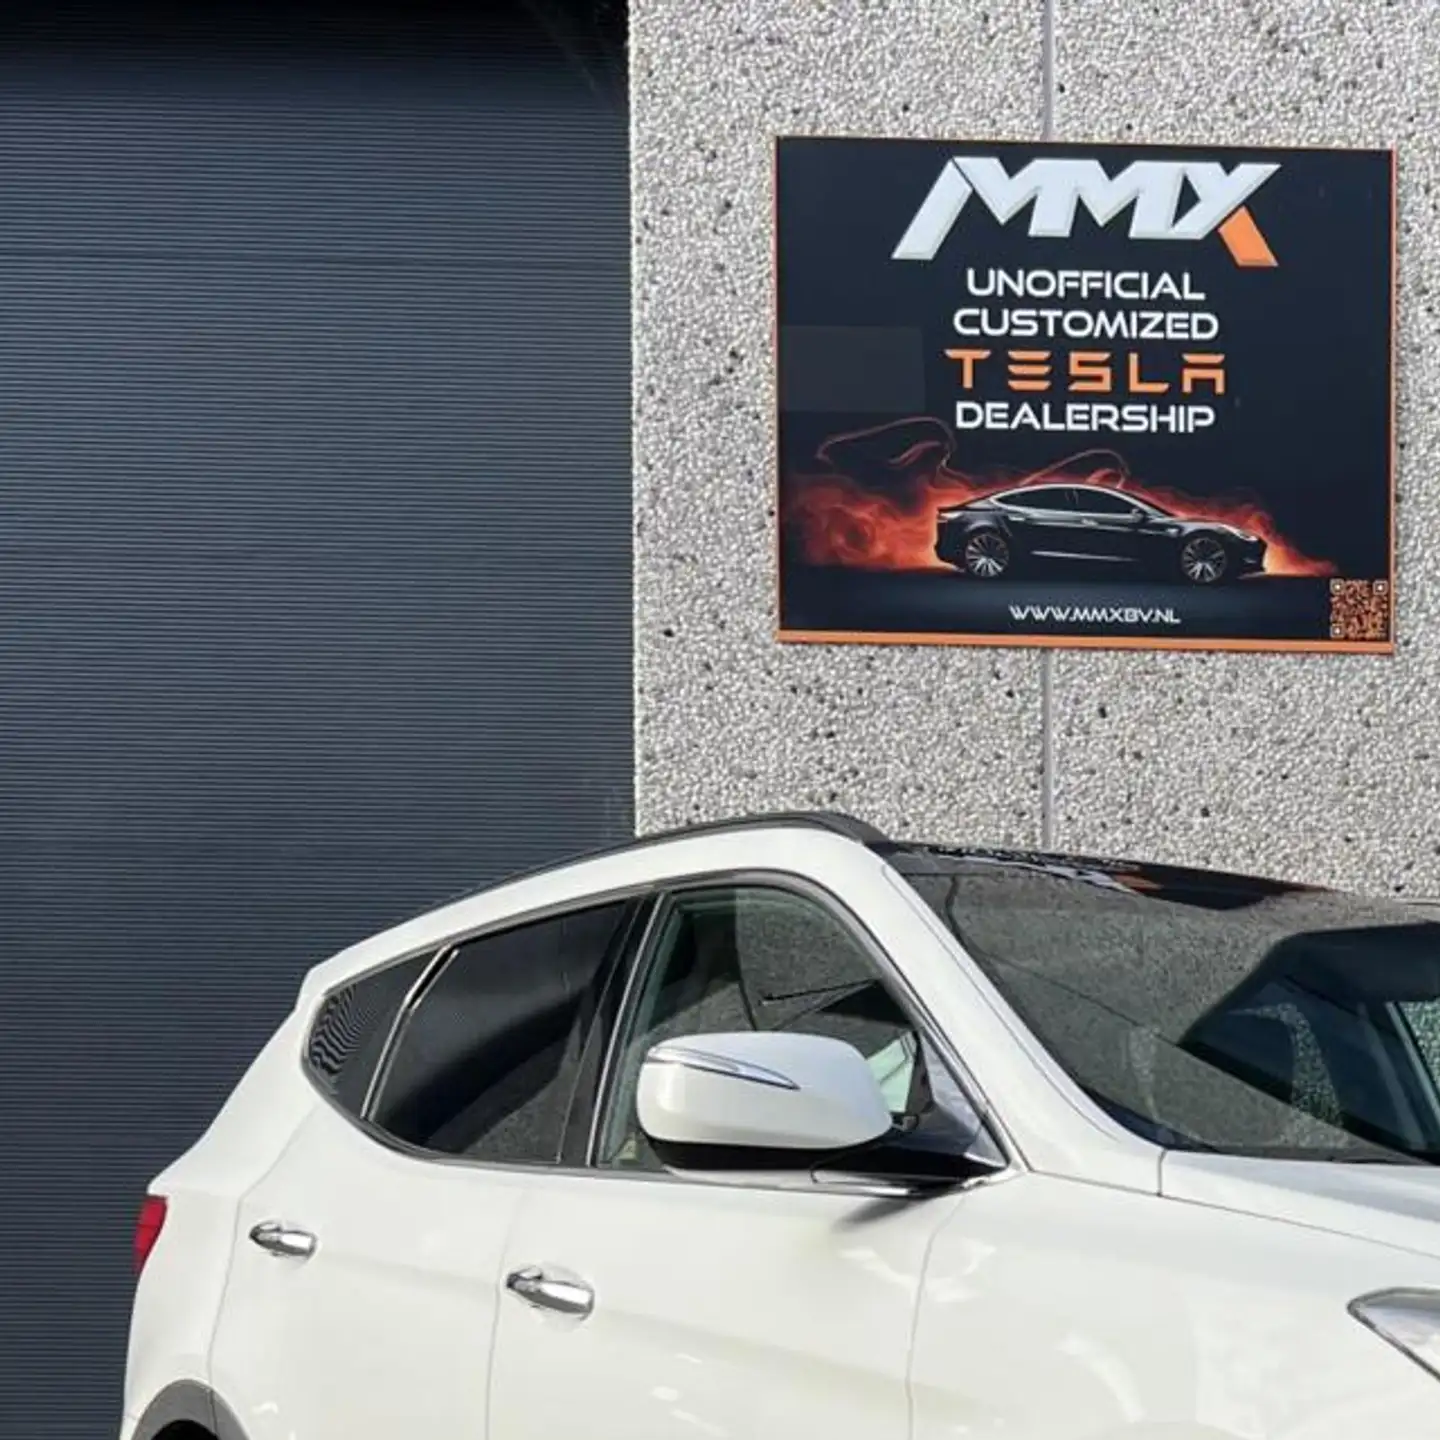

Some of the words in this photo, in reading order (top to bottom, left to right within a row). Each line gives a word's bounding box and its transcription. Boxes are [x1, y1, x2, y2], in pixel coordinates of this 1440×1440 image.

[892, 156, 1281, 267] MMX
[966, 268, 1206, 301] UNOFFICIAL
[953, 308, 1219, 340] CUSTOMIZED
[944, 348, 1226, 395] TESLA
[955, 401, 1216, 433] DEALERSHIP
[1008, 604, 1182, 624] WWW.MMXBV.NL
